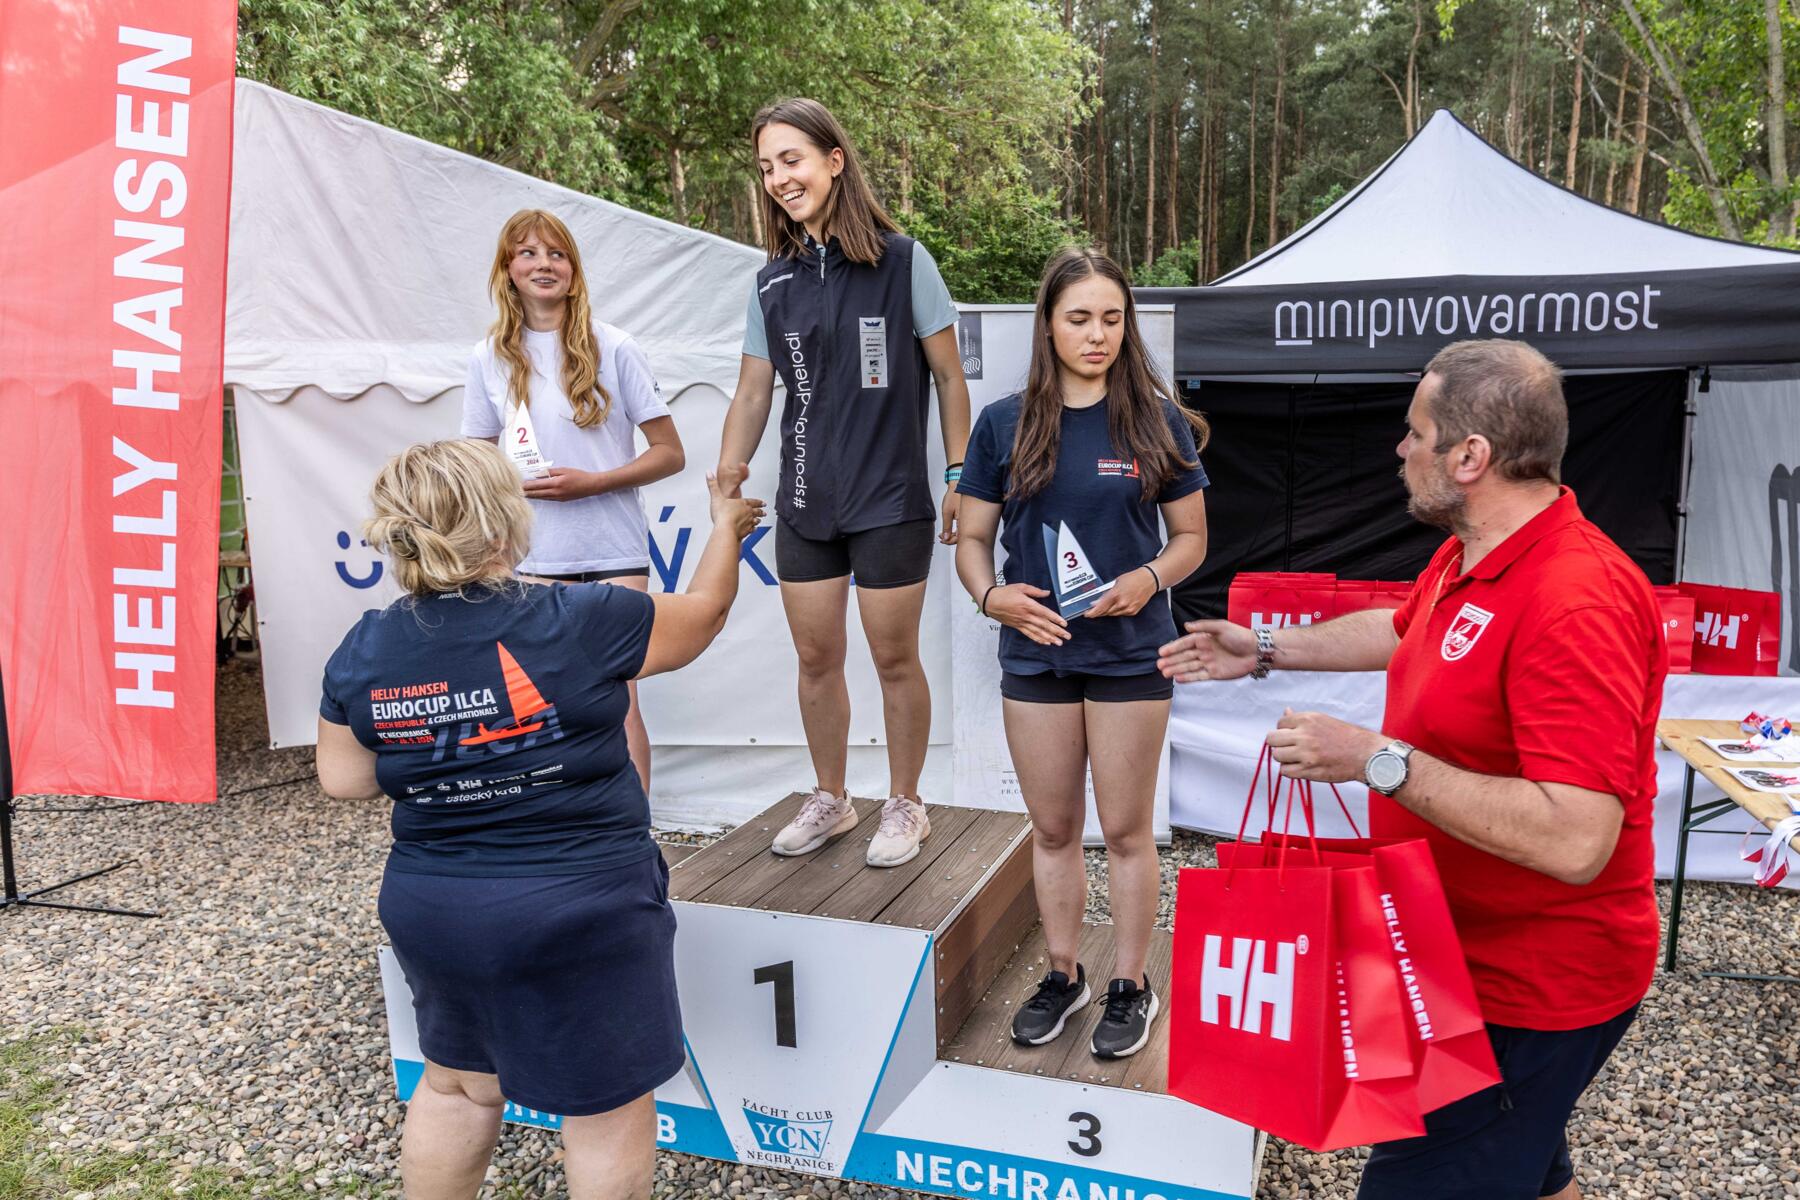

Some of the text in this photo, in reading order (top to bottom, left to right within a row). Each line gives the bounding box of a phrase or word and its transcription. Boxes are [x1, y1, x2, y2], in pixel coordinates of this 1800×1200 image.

[1275, 284, 1661, 349] minipivovarmost
[112, 25, 194, 709] HELLY HANSEN
[516, 427, 529, 445] 2
[1063, 551, 1079, 569] 3
[370, 681, 449, 701] HELLY HANSEN
[371, 687, 497, 720] EUROCUP ILCA
[374, 720, 395, 729] CZECH
[394, 718, 427, 729] REPUBLIC
[433, 714, 457, 724] CZECH
[457, 706, 500, 720] NATIONALS
[494, 785, 522, 797] kraj
[1379, 893, 1435, 1041] HELLY HANSEN
[753, 959, 798, 1049] 1
[742, 1097, 834, 1121] YACHT CLUB
[755, 1121, 822, 1153] YCN
[1066, 1111, 1103, 1158] 3
[746, 1150, 835, 1172] NECHRANICE
